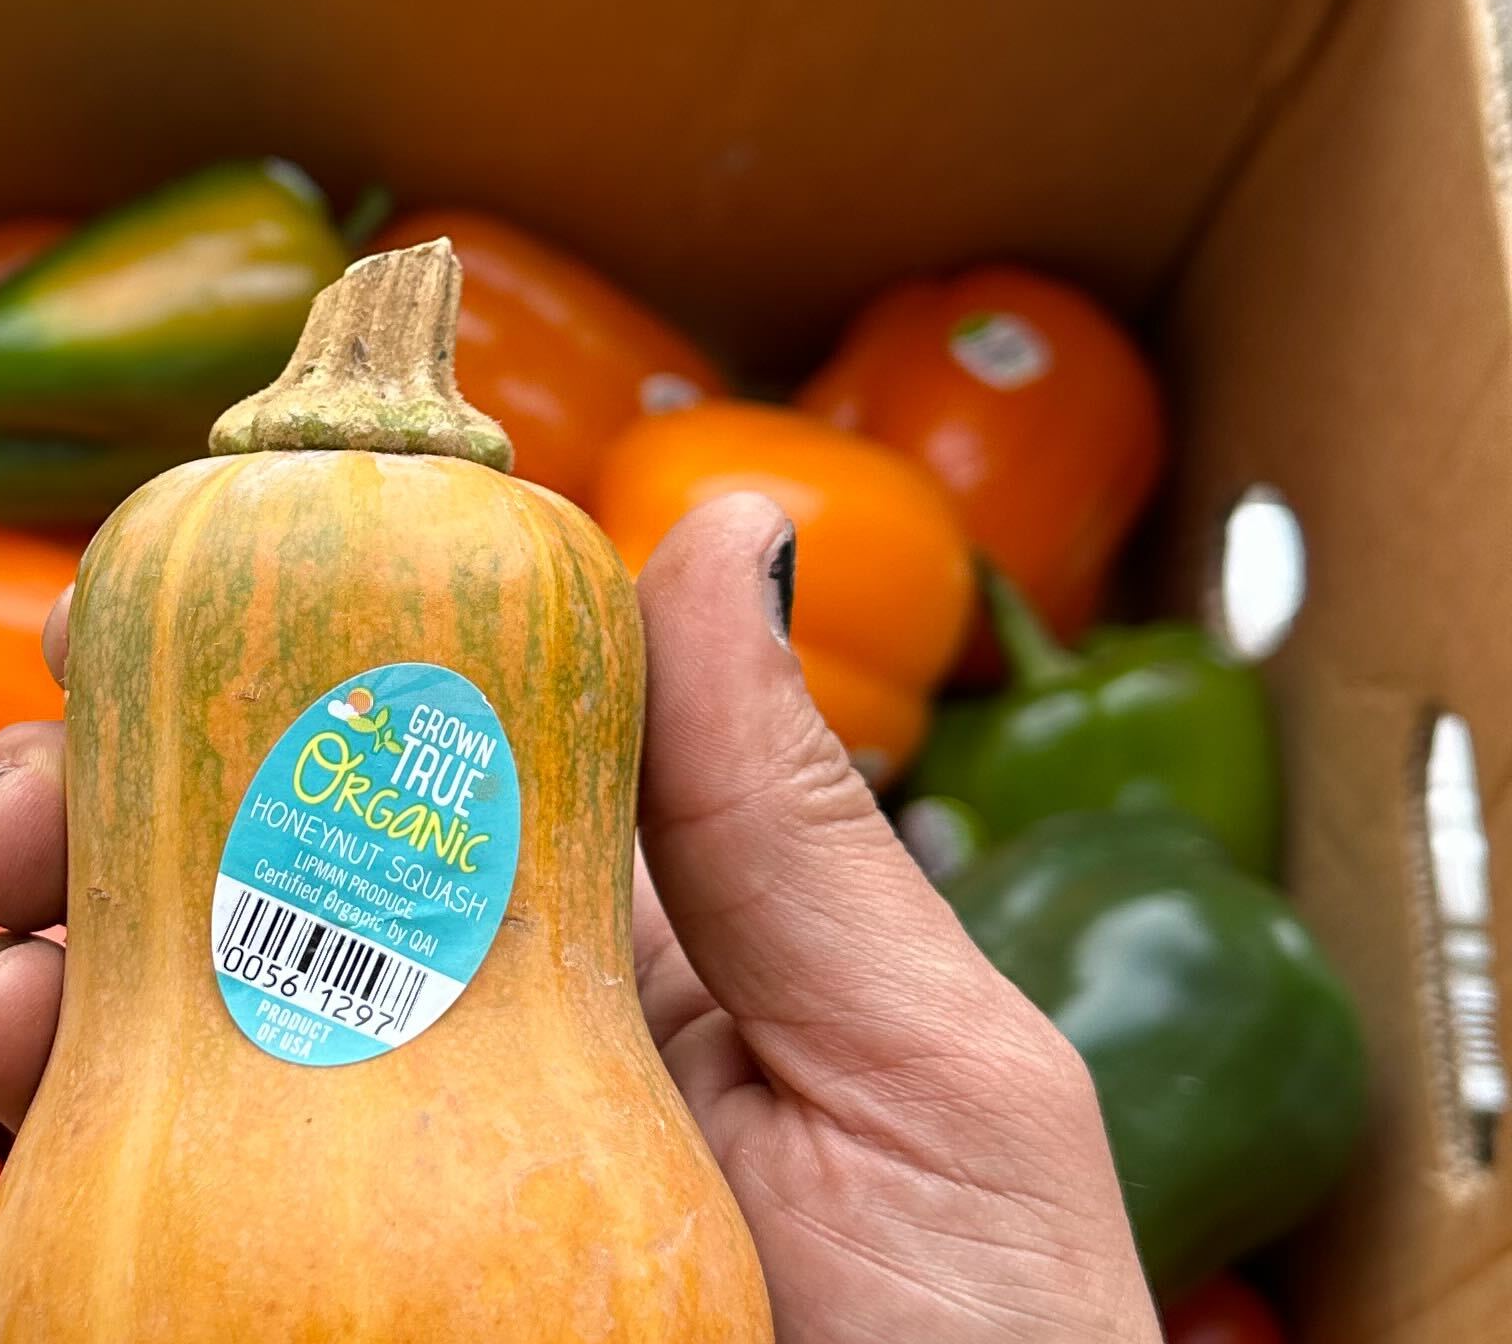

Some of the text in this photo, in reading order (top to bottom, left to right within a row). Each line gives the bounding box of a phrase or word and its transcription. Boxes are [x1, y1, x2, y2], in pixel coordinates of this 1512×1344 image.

[408, 704, 497, 768] GROWN
[390, 733, 485, 817] TRUE
[250, 792, 488, 921] HONEYNUT SQUASH
[294, 850, 417, 919] LIPMAN PRODUCE
[254, 858, 438, 958] Certified Organic by QAI
[223, 946, 395, 1035] 0056 1297
[255, 999, 333, 1042] PRODUCT
[256, 1024, 311, 1059] OF USA
